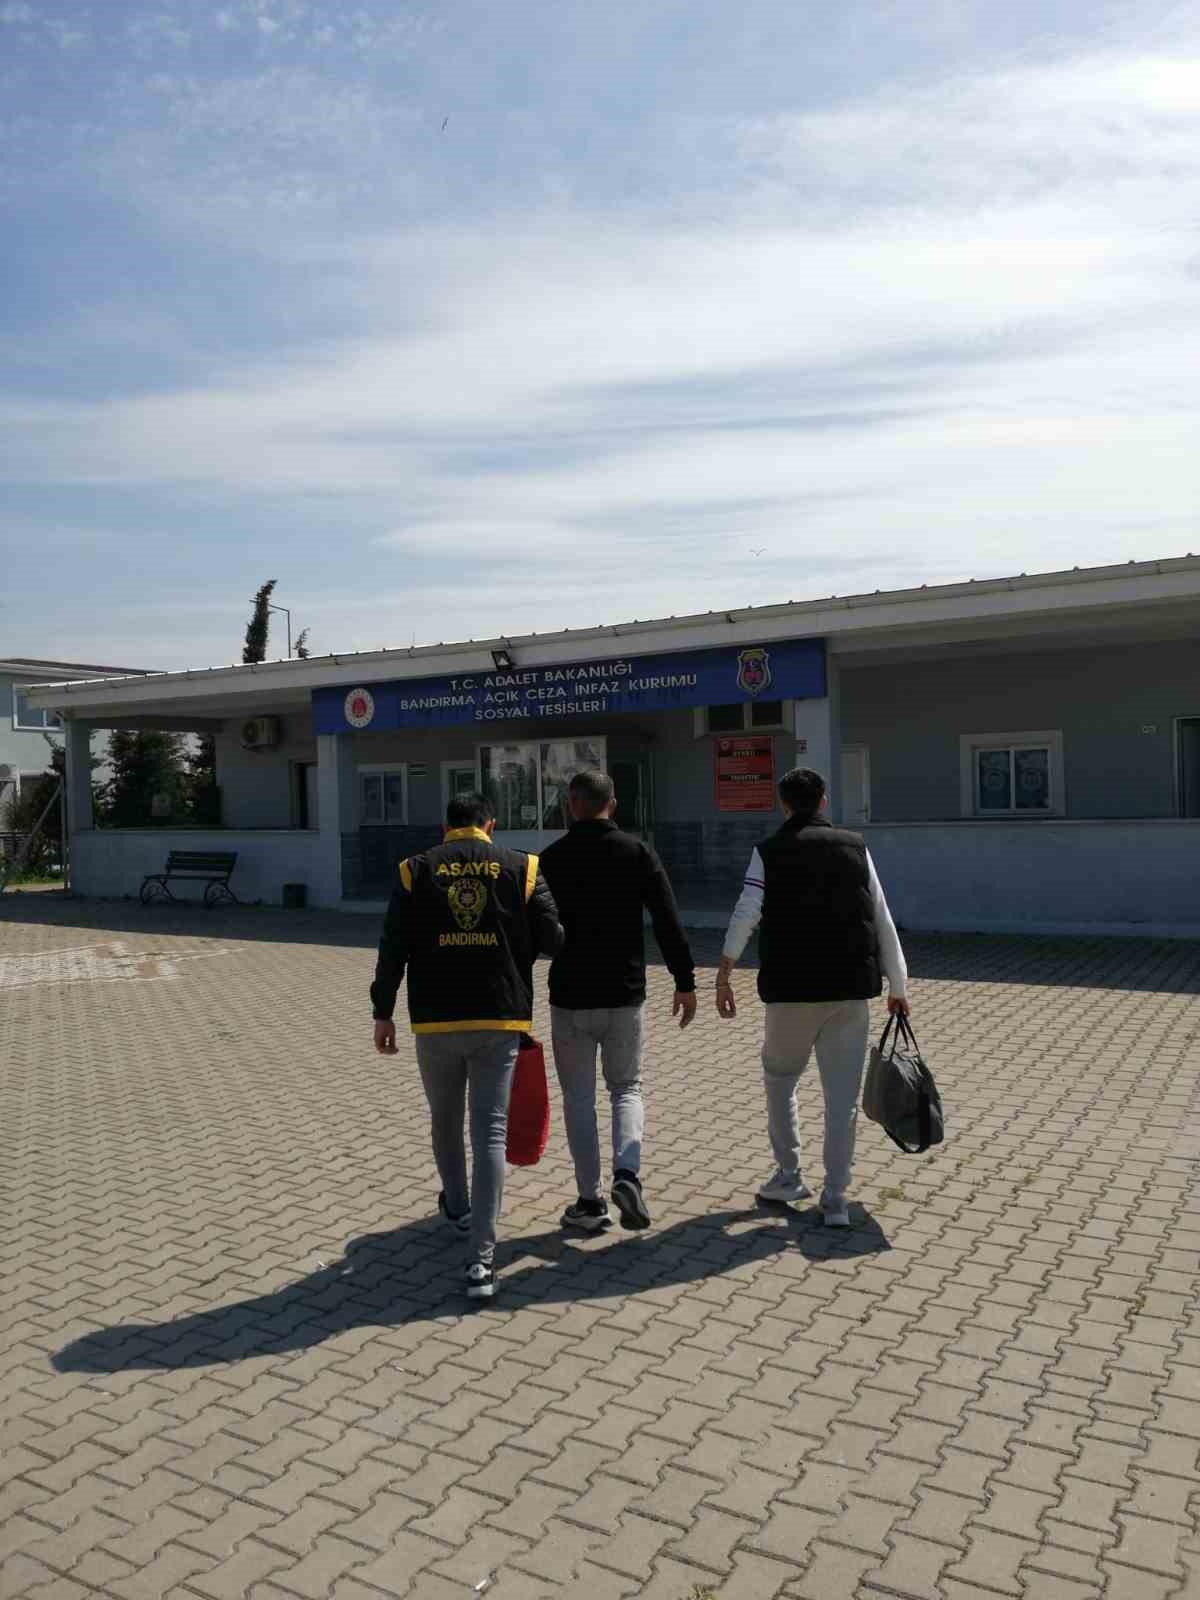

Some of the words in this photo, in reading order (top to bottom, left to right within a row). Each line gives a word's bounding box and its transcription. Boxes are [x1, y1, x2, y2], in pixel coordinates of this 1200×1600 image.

[451, 679, 478, 690] T.C.
[484, 672, 538, 687] ADALET
[544, 660, 632, 682] BAKANLIĞI
[400, 695, 475, 710] BANDIRMA
[526, 686, 567, 700] CEZA
[575, 680, 620, 696] İNFAZ
[629, 674, 697, 691] KURUMU
[474, 706, 530, 720] SOSYAL
[538, 696, 607, 716] TESİSLERİ
[436, 860, 501, 879] ASAYİŞ
[439, 932, 498, 946] BANDIRMA
